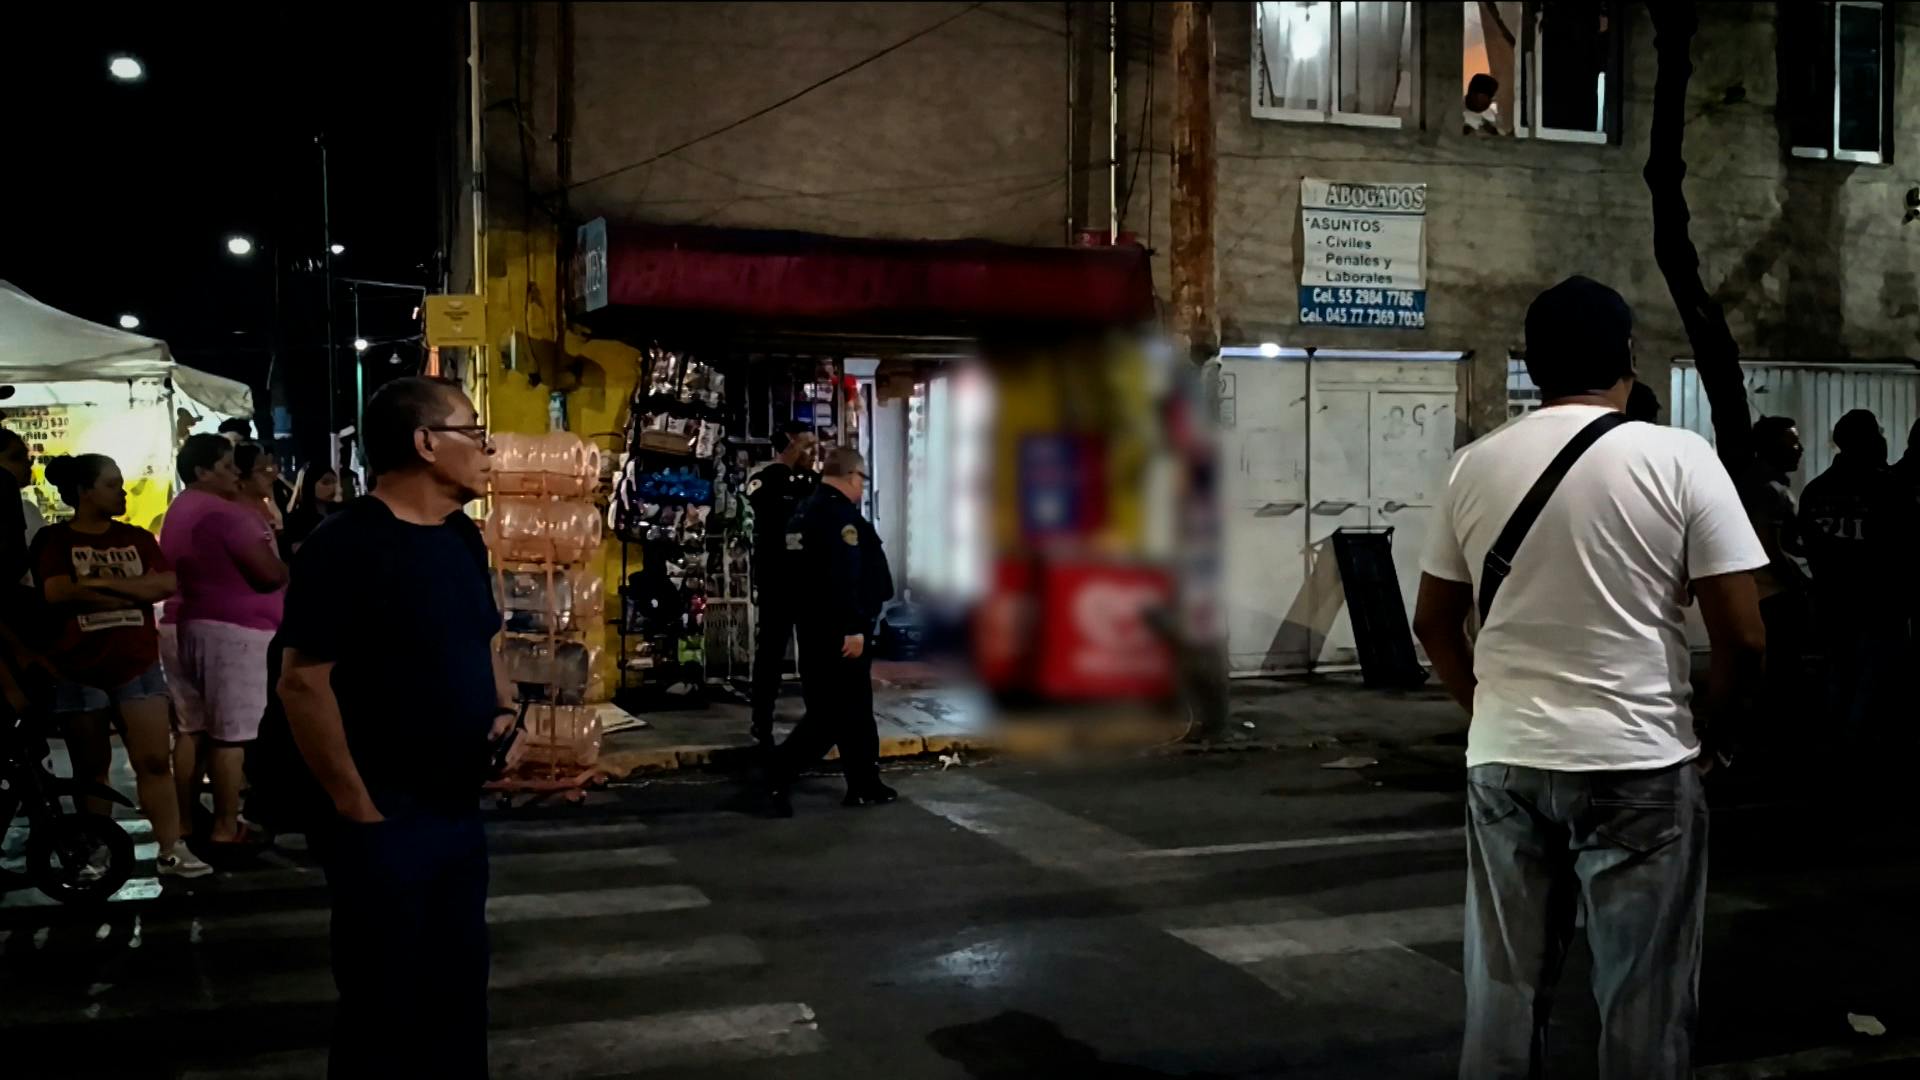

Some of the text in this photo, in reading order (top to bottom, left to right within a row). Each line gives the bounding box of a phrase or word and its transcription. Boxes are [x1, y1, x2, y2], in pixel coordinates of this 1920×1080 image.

[1326, 183, 1426, 209] ABOGADOS
[1326, 235, 1372, 249] Civiles
[1326, 253, 1392, 270] Penales y
[1326, 271, 1393, 284] Laborales
[1313, 287, 1335, 303] Cel.
[1339, 289, 1353, 303] 55
[1301, 307, 1323, 322] Cel.
[1326, 307, 1347, 322] 045
[1350, 308, 1364, 323] 77
